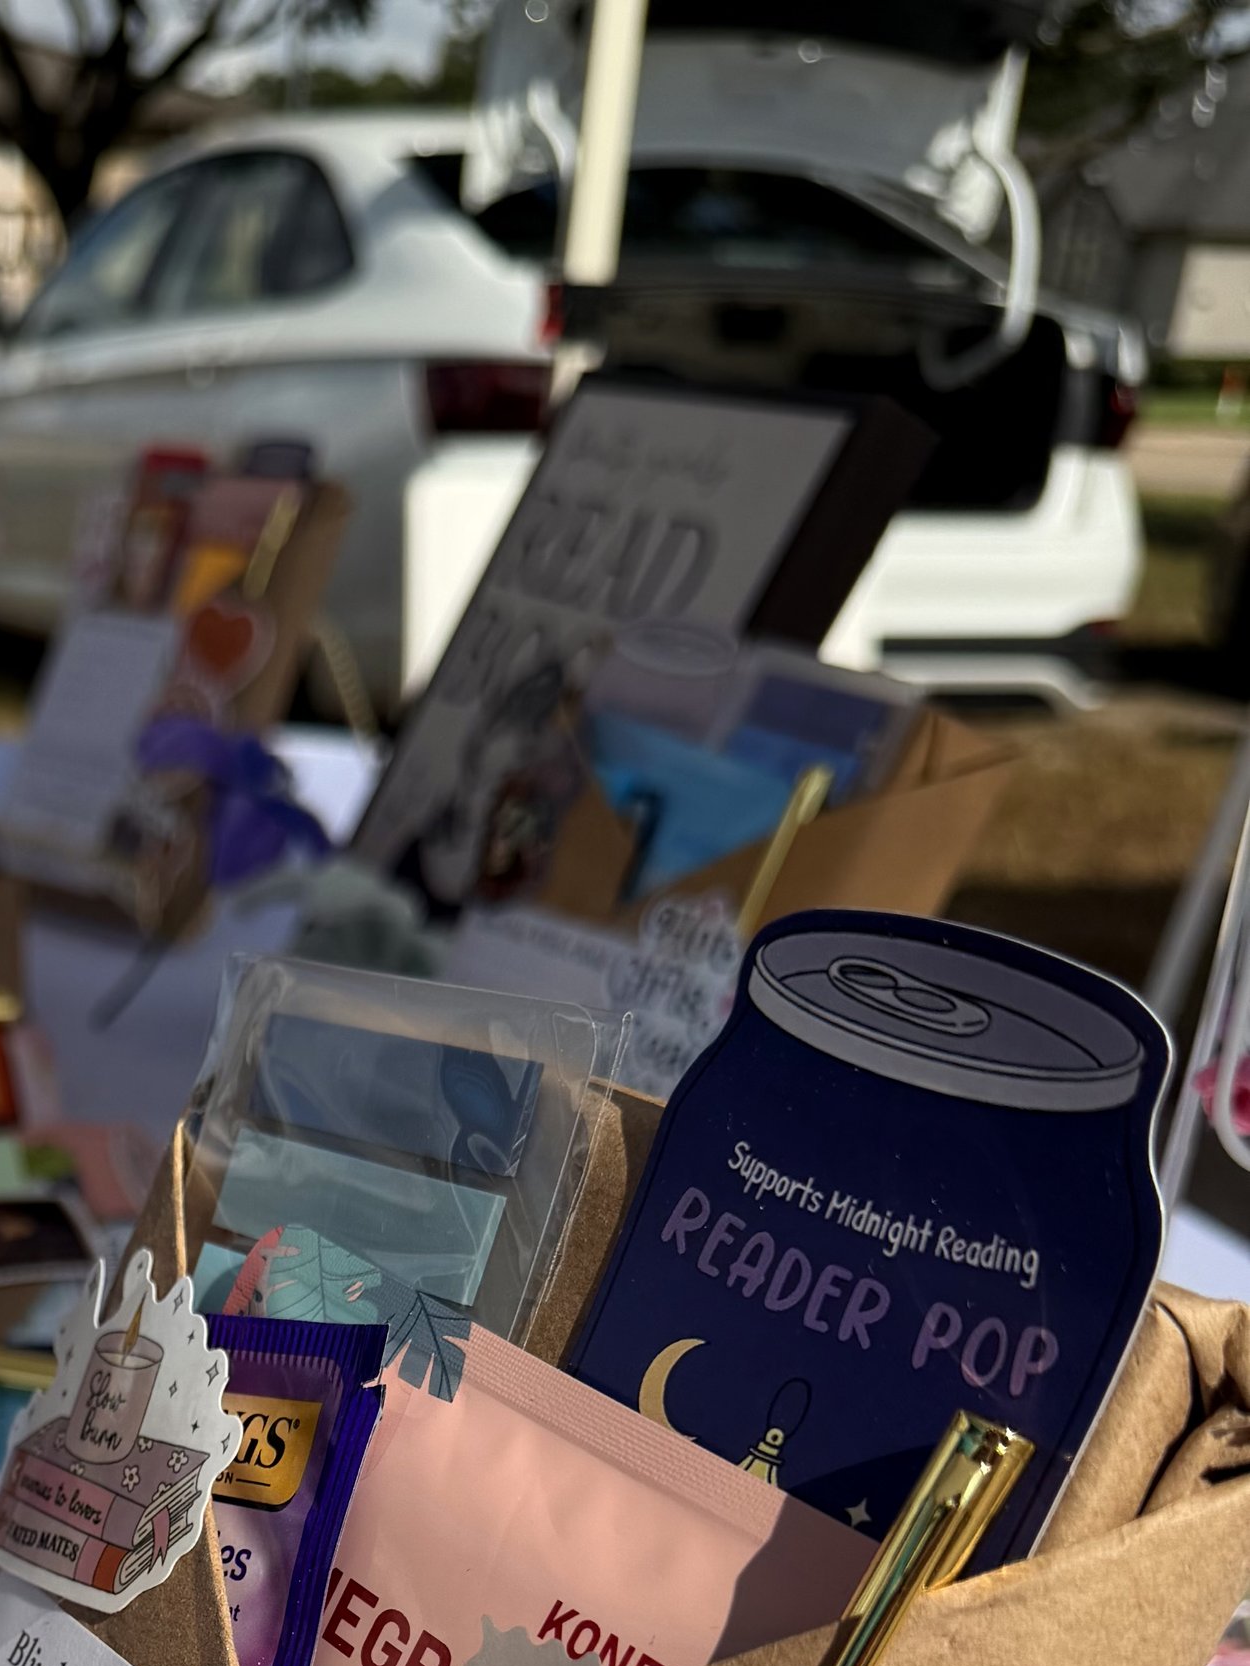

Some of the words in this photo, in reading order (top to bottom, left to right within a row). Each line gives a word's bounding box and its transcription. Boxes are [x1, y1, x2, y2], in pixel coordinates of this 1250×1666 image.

[727, 1140, 824, 1213] Supports
[824, 1190, 934, 1257] Midnight
[934, 1225, 1040, 1289] Reading
[661, 1187, 891, 1349] READER
[911, 1302, 1060, 1397] POP
[36, 1531, 81, 1562] MATES
[54, 1481, 67, 1507] to
[68, 1490, 103, 1525] lovers
